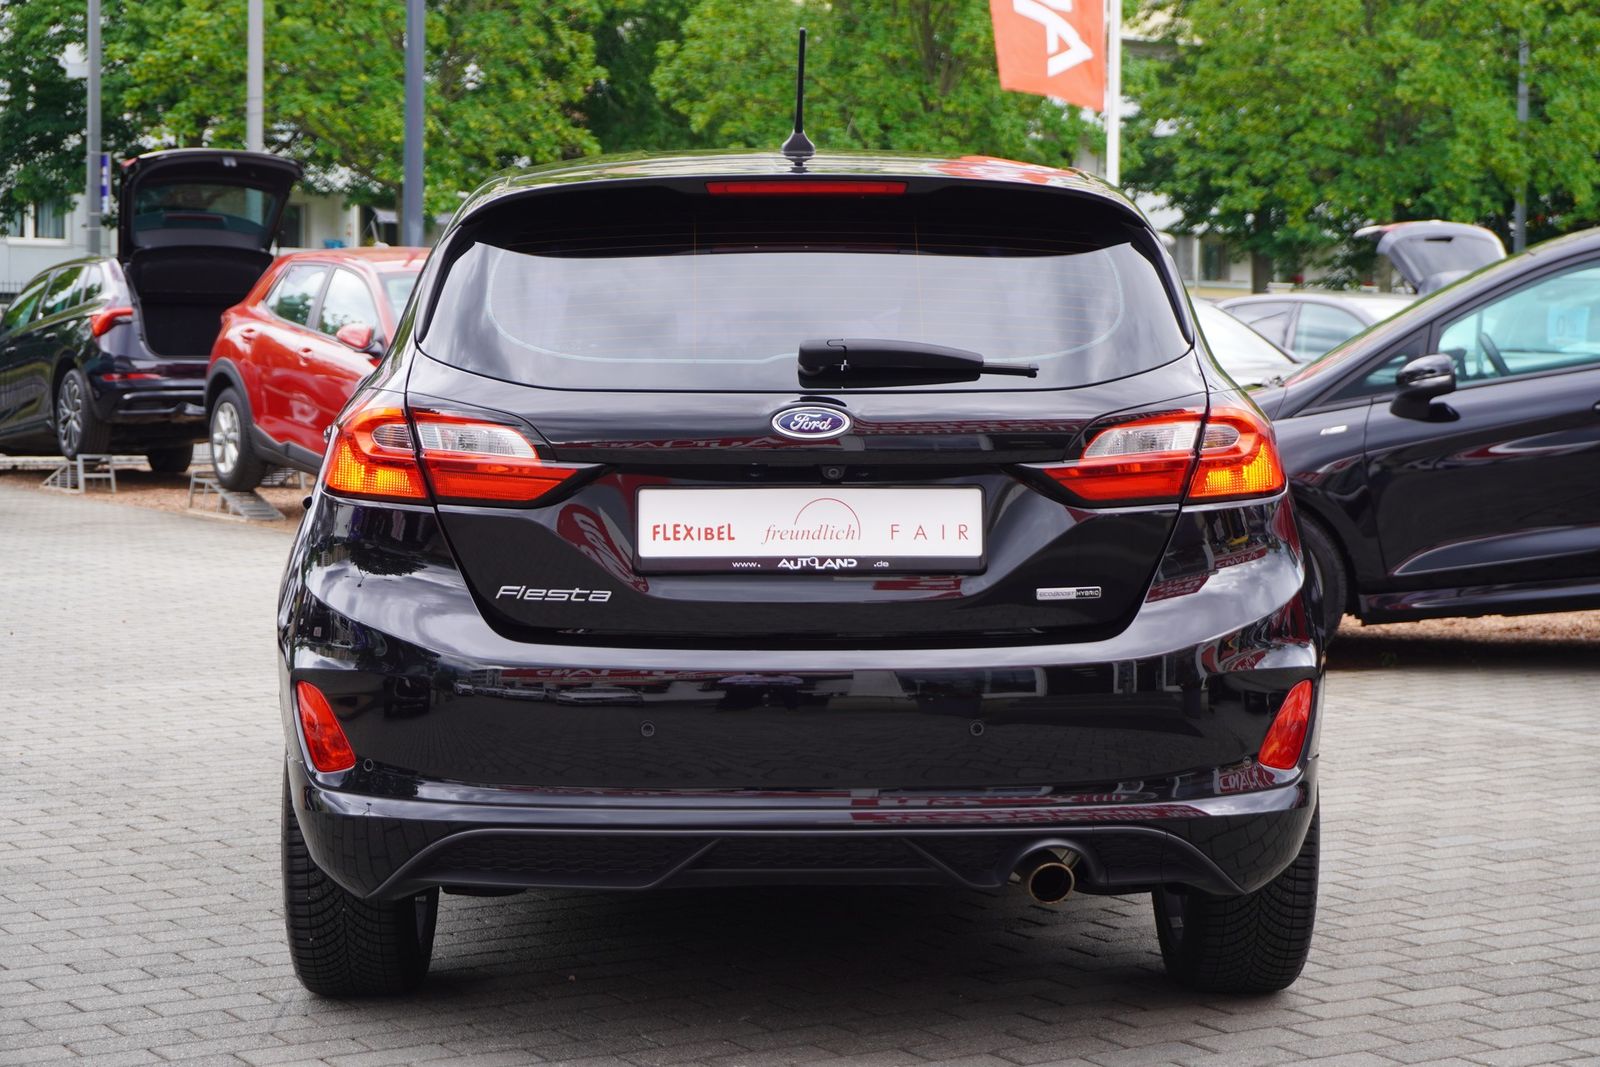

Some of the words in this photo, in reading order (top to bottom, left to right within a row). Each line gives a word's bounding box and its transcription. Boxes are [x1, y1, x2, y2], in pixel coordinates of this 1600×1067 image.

[789, 413, 832, 431] Ford
[652, 523, 736, 542] FLEXIBEL
[760, 523, 856, 545] freundlich
[890, 523, 969, 541] FAIR
[777, 556, 858, 570] AUTOLAND
[495, 585, 612, 602] Fiesta
